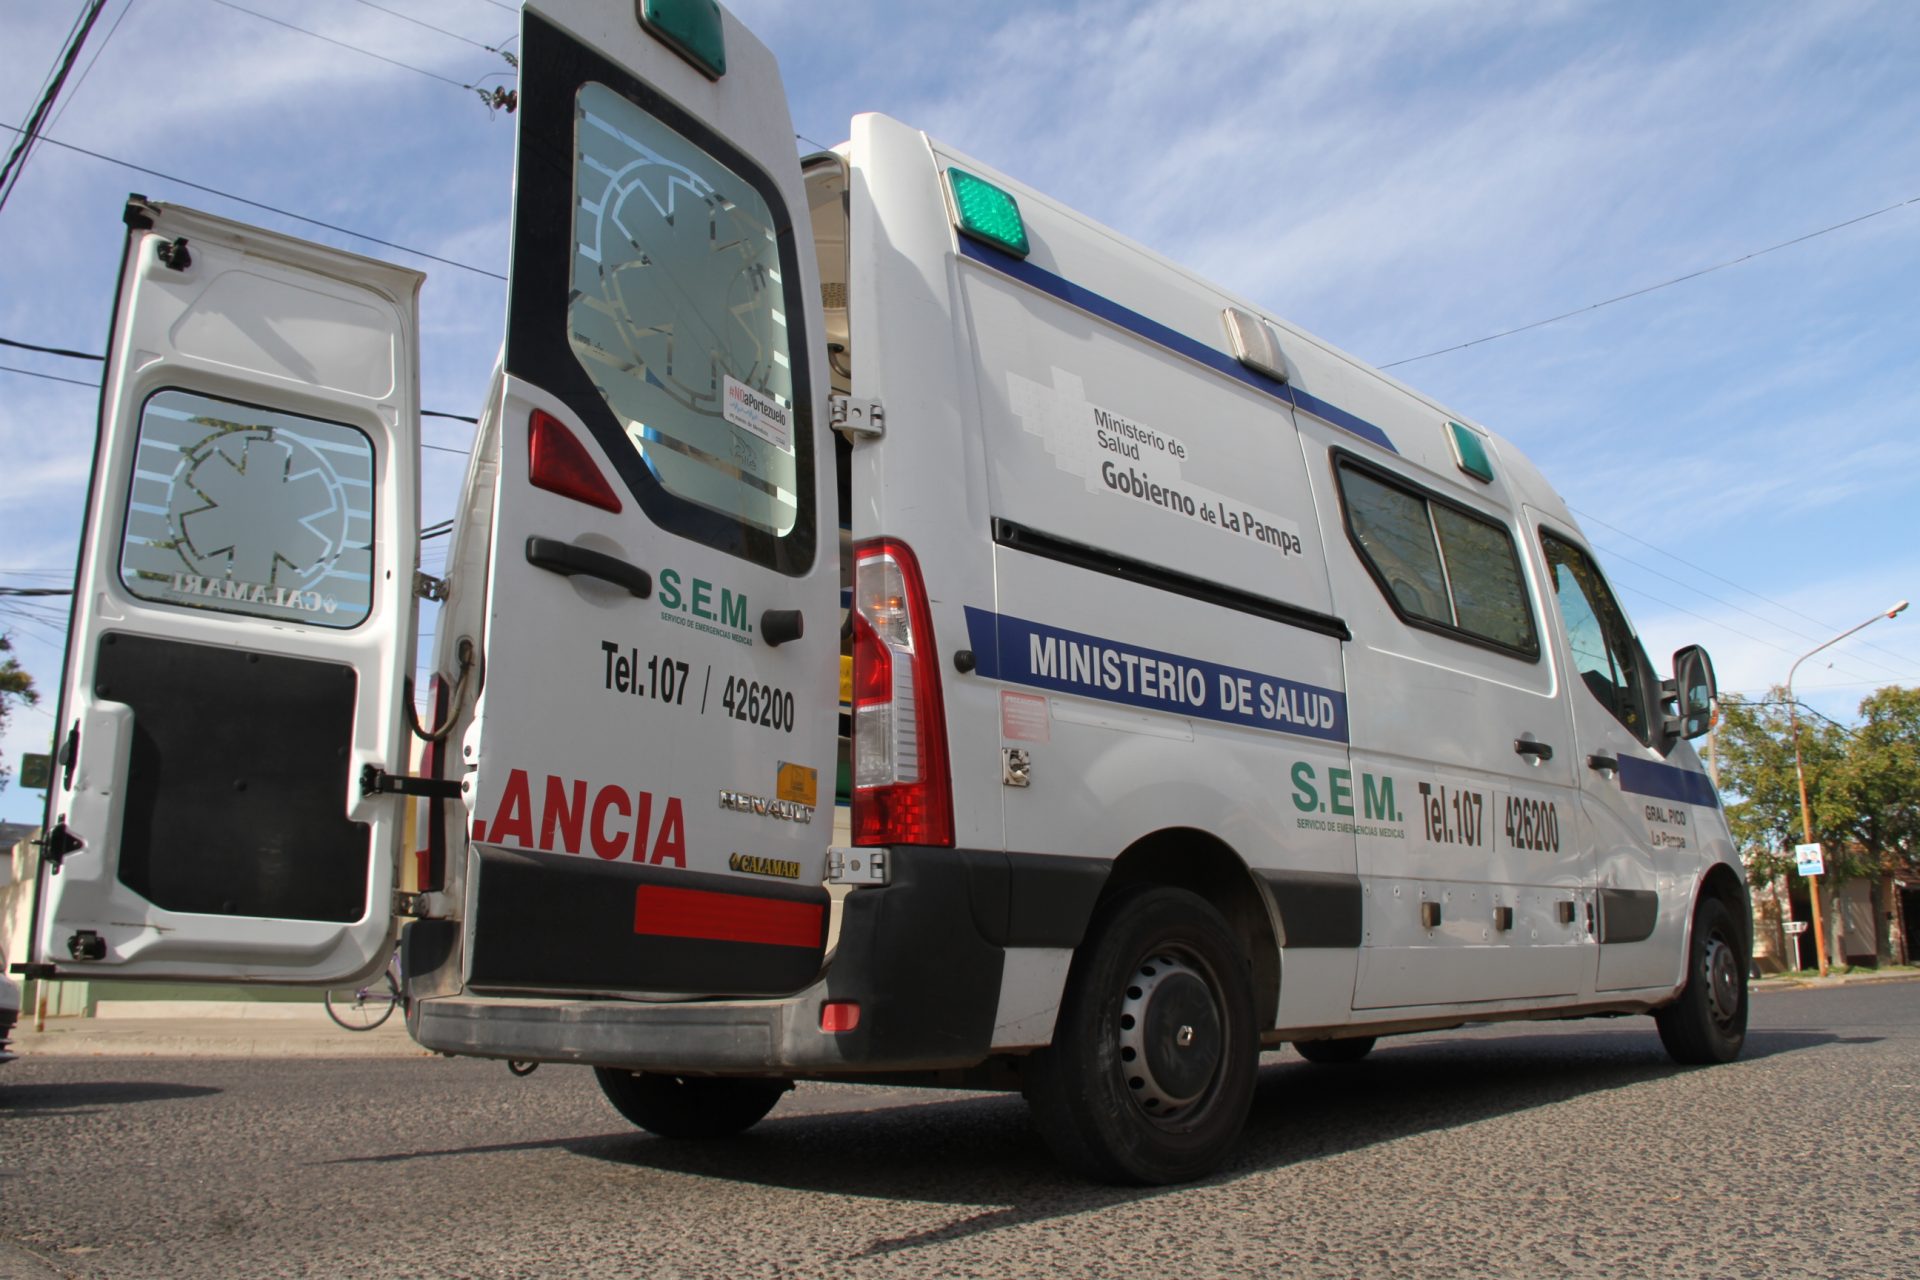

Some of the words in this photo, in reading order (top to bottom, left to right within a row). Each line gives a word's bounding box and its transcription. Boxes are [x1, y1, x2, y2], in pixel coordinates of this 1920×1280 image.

[1094, 408, 1165, 451] Ministerio
[1168, 439, 1185, 459] de
[1097, 430, 1140, 461] Salud
[1102, 460, 1195, 516] Gobierno
[1200, 503, 1216, 525] de
[1219, 502, 1240, 533] La
[1243, 511, 1302, 556] Pampa
[659, 568, 753, 633] S.E.M.
[661, 611, 686, 627] SERVICIO
[687, 619, 694, 629] DE
[695, 621, 731, 640] EMERGENCIAS
[602, 640, 689, 705] Tel.107
[723, 675, 794, 733] 426200
[1030, 633, 1206, 707] MINISTERIO
[1219, 674, 1254, 715] DE
[1260, 682, 1335, 730] SALUD
[720, 789, 815, 824] RENAULT
[1297, 818, 1325, 832] SERVICIO
[1327, 821, 1336, 832] DE
[1419, 782, 1482, 846] Tel.107
[1506, 796, 1559, 853] 426200
[1651, 830, 1661, 846] La
[740, 854, 801, 879] CALAMARI
